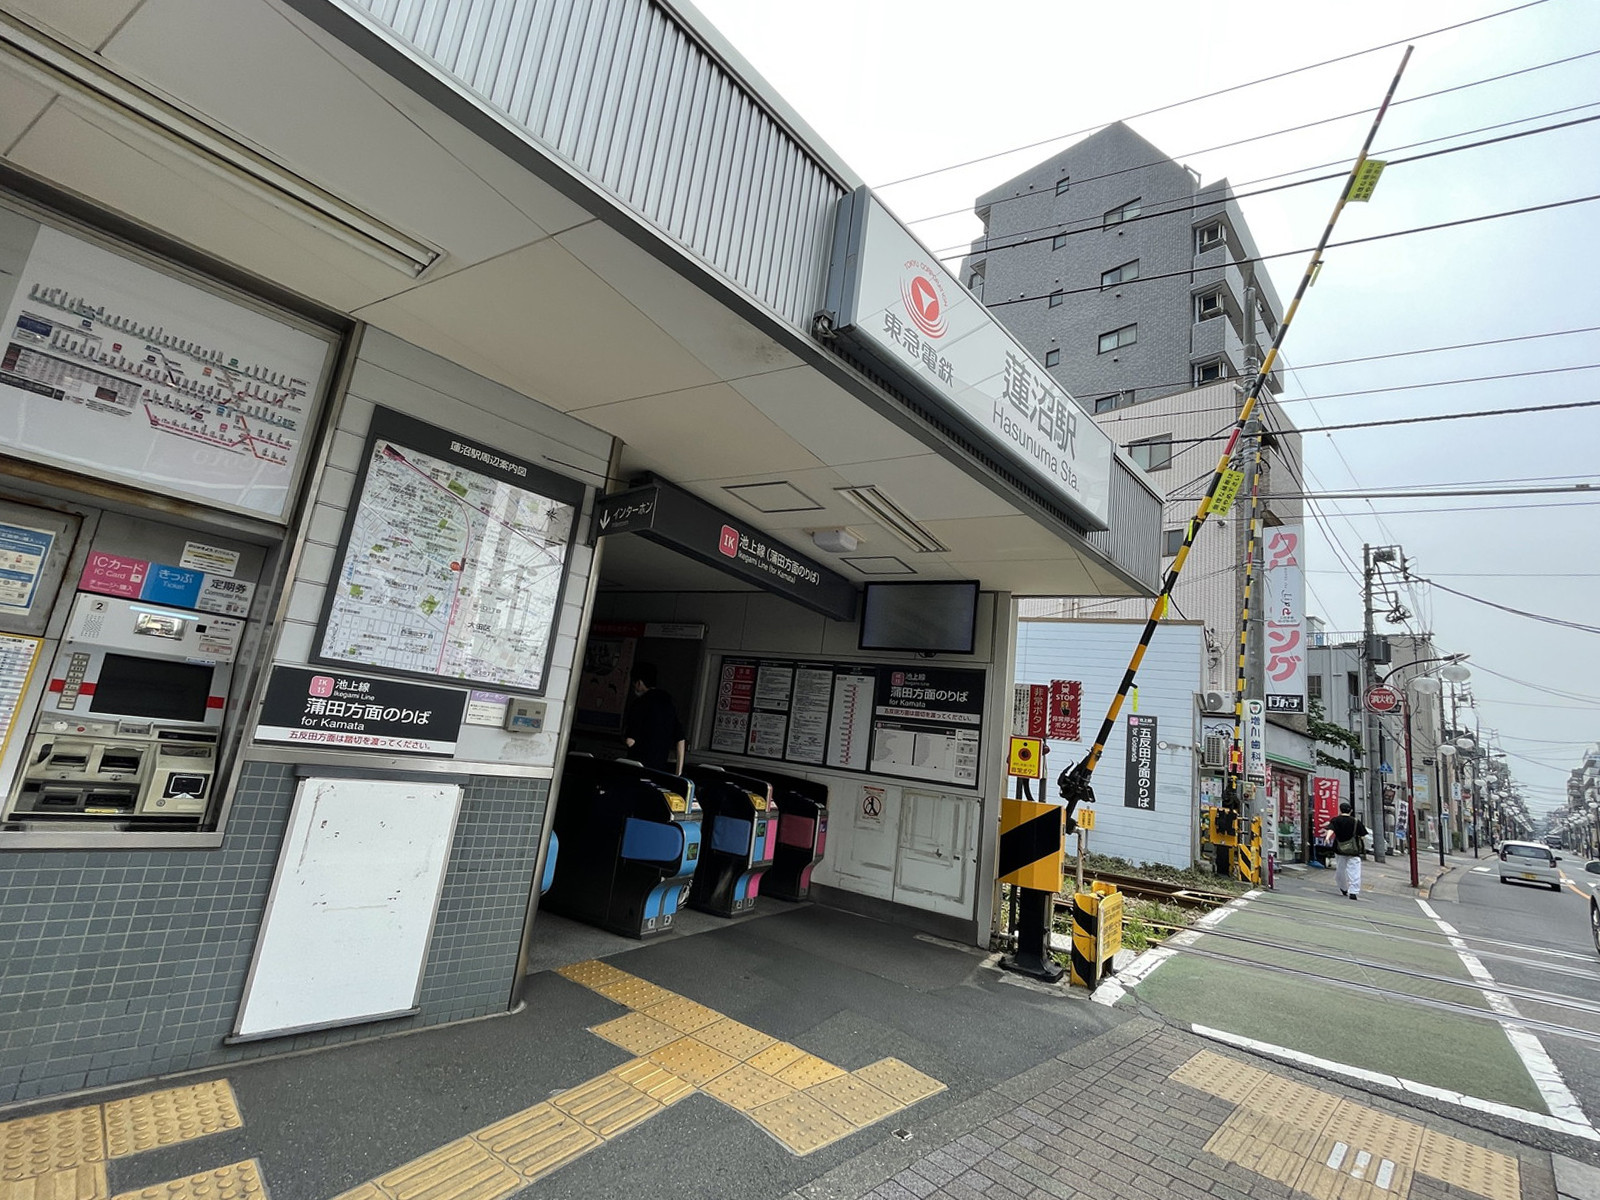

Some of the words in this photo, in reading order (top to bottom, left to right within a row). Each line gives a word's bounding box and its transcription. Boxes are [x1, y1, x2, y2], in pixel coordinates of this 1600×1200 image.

[884, 308, 955, 389] 東急電鉄
[1002, 350, 1078, 461] 蓮沼駅
[992, 401, 1058, 474] Hasunuma
[1060, 461, 1081, 493] Sta.
[450, 440, 528, 477] 蓮沼駅周辺案内図
[612, 502, 654, 520] インターホン
[723, 534, 735, 550] IK
[92, 555, 145, 573] ICカード
[94, 568, 103, 576] IC
[105, 570, 127, 580] Card
[158, 569, 195, 584] きっぷ
[210, 578, 247, 594] 定期券
[96, 602, 104, 611] 2
[316, 686, 327, 695] 15
[317, 678, 328, 687] IK
[335, 678, 371, 693] 池上線
[333, 690, 360, 701] Ikegami
[360, 693, 376, 701] Line
[890, 686, 969, 703] 蒲田方面のりば
[1055, 693, 1075, 702] STOP
[304, 697, 432, 725] 蒲田方面のりば
[888, 698, 899, 706] for
[899, 699, 926, 708] Kamata
[1032, 686, 1044, 733] 非常ボタン
[301, 715, 318, 727] for
[320, 718, 366, 731] Kamata
[1054, 722, 1074, 730] ボタン
[288, 730, 431, 750] 五反田方面は踏切を渡ってください。
[1138, 728, 1152, 808] 五反田方面のりば
